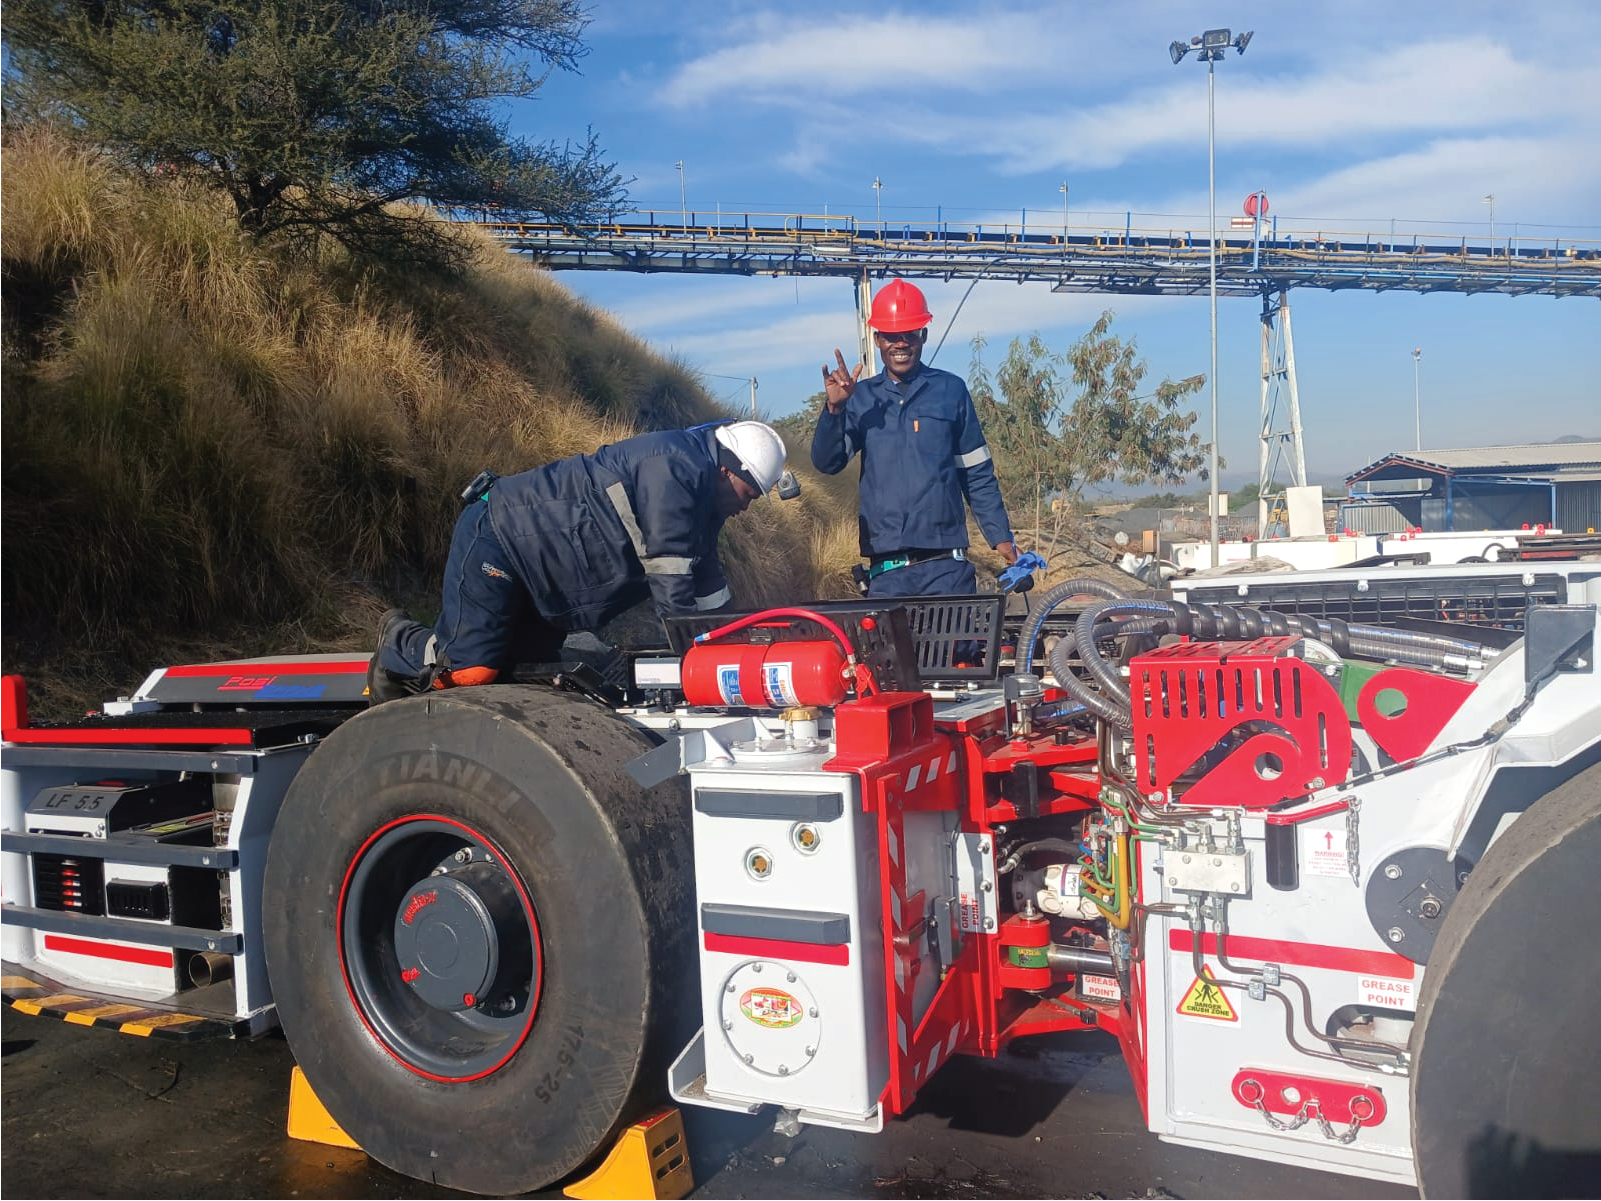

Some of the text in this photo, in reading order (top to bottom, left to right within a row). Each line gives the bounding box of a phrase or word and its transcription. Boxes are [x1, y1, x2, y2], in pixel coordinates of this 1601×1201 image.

[45, 793, 104, 810] LF 5.5
[961, 893, 969, 929] GREASE
[971, 898, 979, 926] POINT
[1084, 975, 1119, 988] GREASE
[1361, 979, 1410, 994] GREASE
[1088, 986, 1115, 998] POINT
[1194, 1001, 1222, 1009] DANGER
[1367, 993, 1406, 1007] POINT
[1186, 1005, 1210, 1013] CRUSH
